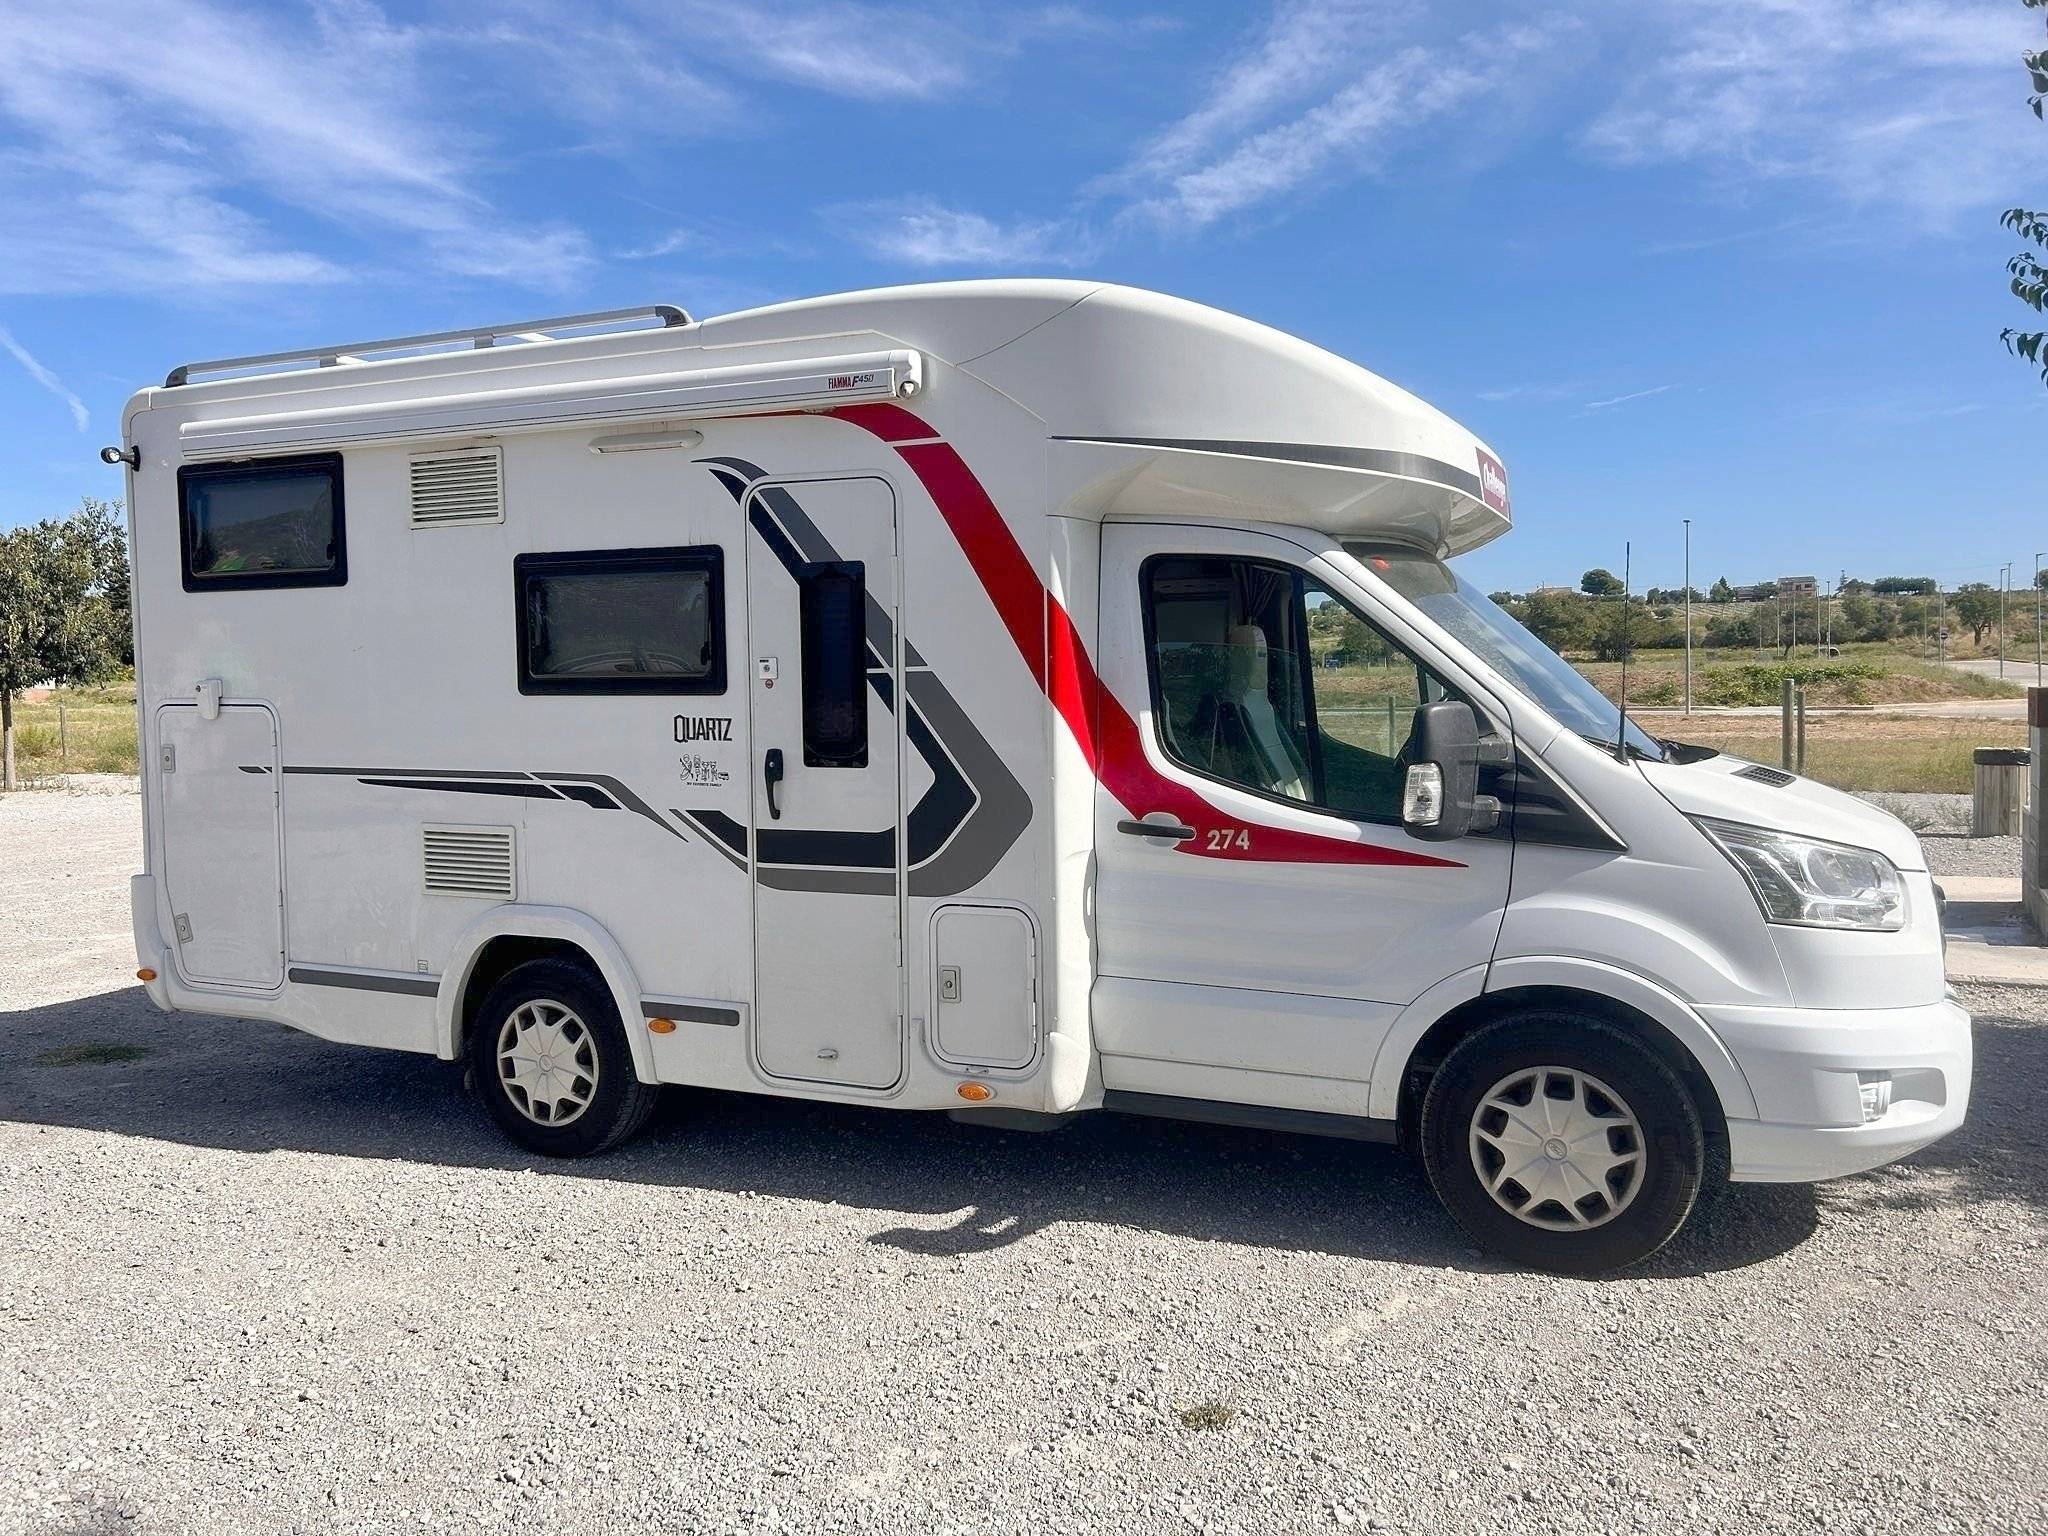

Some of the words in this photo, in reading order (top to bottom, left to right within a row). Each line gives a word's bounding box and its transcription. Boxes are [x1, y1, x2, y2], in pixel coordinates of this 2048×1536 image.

[828, 376, 852, 389] FIAMMA
[673, 714, 733, 743] QUARTZ
[1206, 829, 1250, 850] 274
